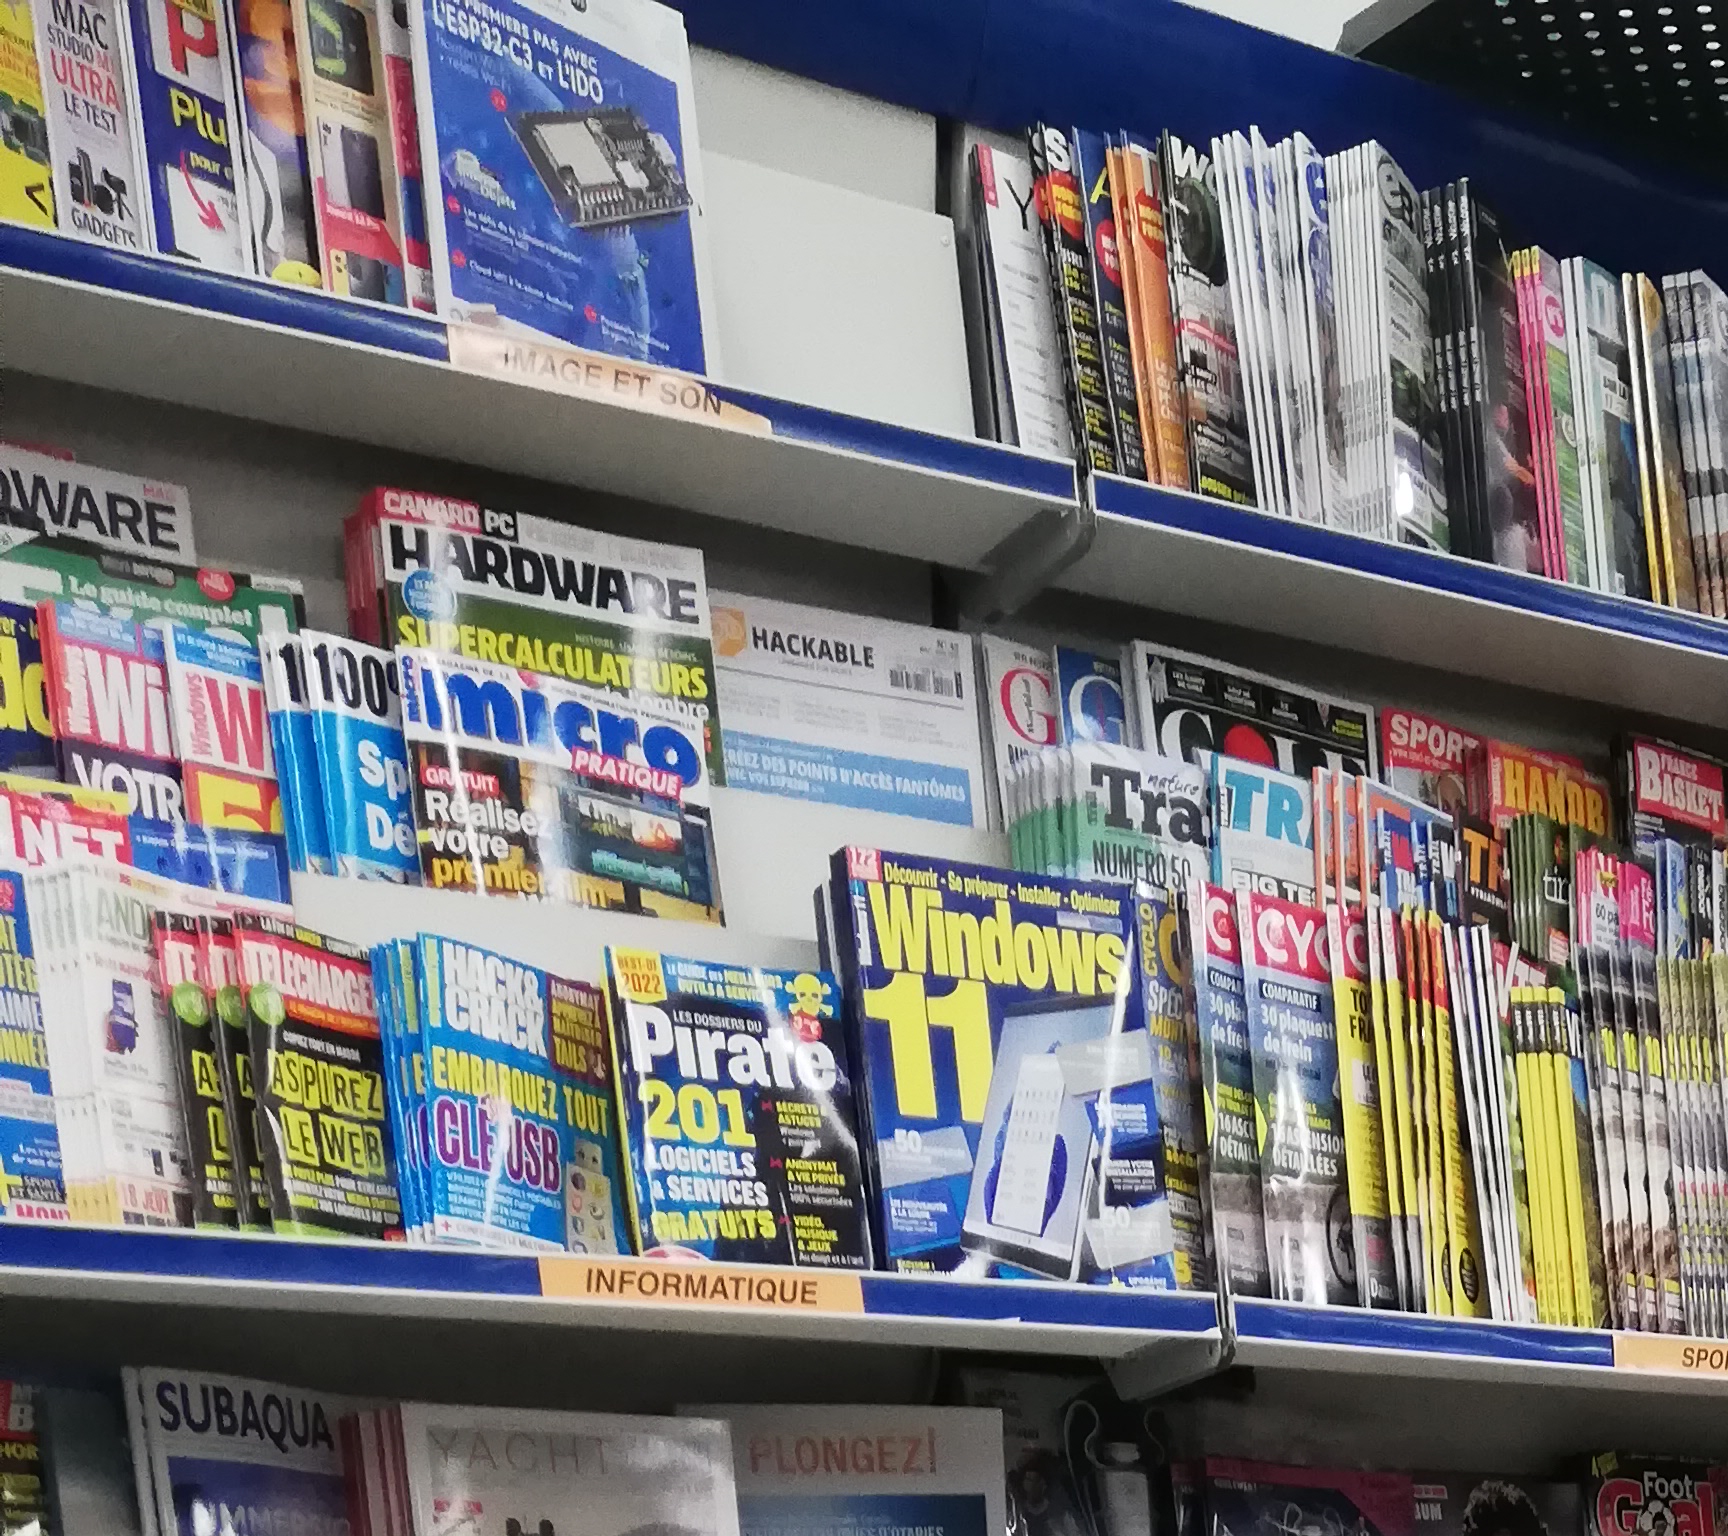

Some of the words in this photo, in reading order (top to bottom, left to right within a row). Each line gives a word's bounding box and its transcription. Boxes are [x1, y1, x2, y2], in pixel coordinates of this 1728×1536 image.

[50, 49, 121, 112] ULTRA
[63, 90, 81, 117] LE
[84, 103, 117, 135] TEST
[71, 208, 136, 248] GADGETS
[504, 347, 602, 388] IMAGE
[613, 369, 651, 397] ET
[660, 382, 721, 416] SON
[384, 492, 479, 532] CANARD
[484, 510, 515, 538] PC
[389, 521, 700, 622] HARDWARE
[752, 625, 875, 670] HACKABLE
[573, 750, 681, 797] PRATIQUE
[429, 826, 508, 860] votre
[882, 862, 938, 891] Découvrir
[947, 874, 961, 891] Se
[962, 879, 1009, 905] préparer
[1018, 885, 1062, 908] Installer
[1070, 894, 1120, 917] Optimiser
[866, 881, 1130, 997] Windows
[622, 973, 662, 994] 2022
[445, 987, 548, 1057] CRACK
[674, 1010, 691, 1024] LES
[694, 1012, 744, 1031] DOSSIERS
[747, 1020, 762, 1033] DU
[626, 1004, 837, 1091] Pirate
[864, 970, 995, 1123] 11
[1264, 1033, 1283, 1052] de
[1284, 1035, 1312, 1064] frein
[272, 1052, 381, 1119] ASPIREZ
[432, 1046, 558, 1121] EMBARQUEZ
[563, 1084, 610, 1138] TOUT
[639, 1080, 756, 1148] 201
[649, 1145, 756, 1177] LOGICIELS
[652, 1209, 776, 1240] GRATUITS
[585, 1267, 818, 1305] INFORMATIQUE
[159, 1381, 334, 1454] SUBAQUA
[1644, 1472, 1694, 1501] Foot
